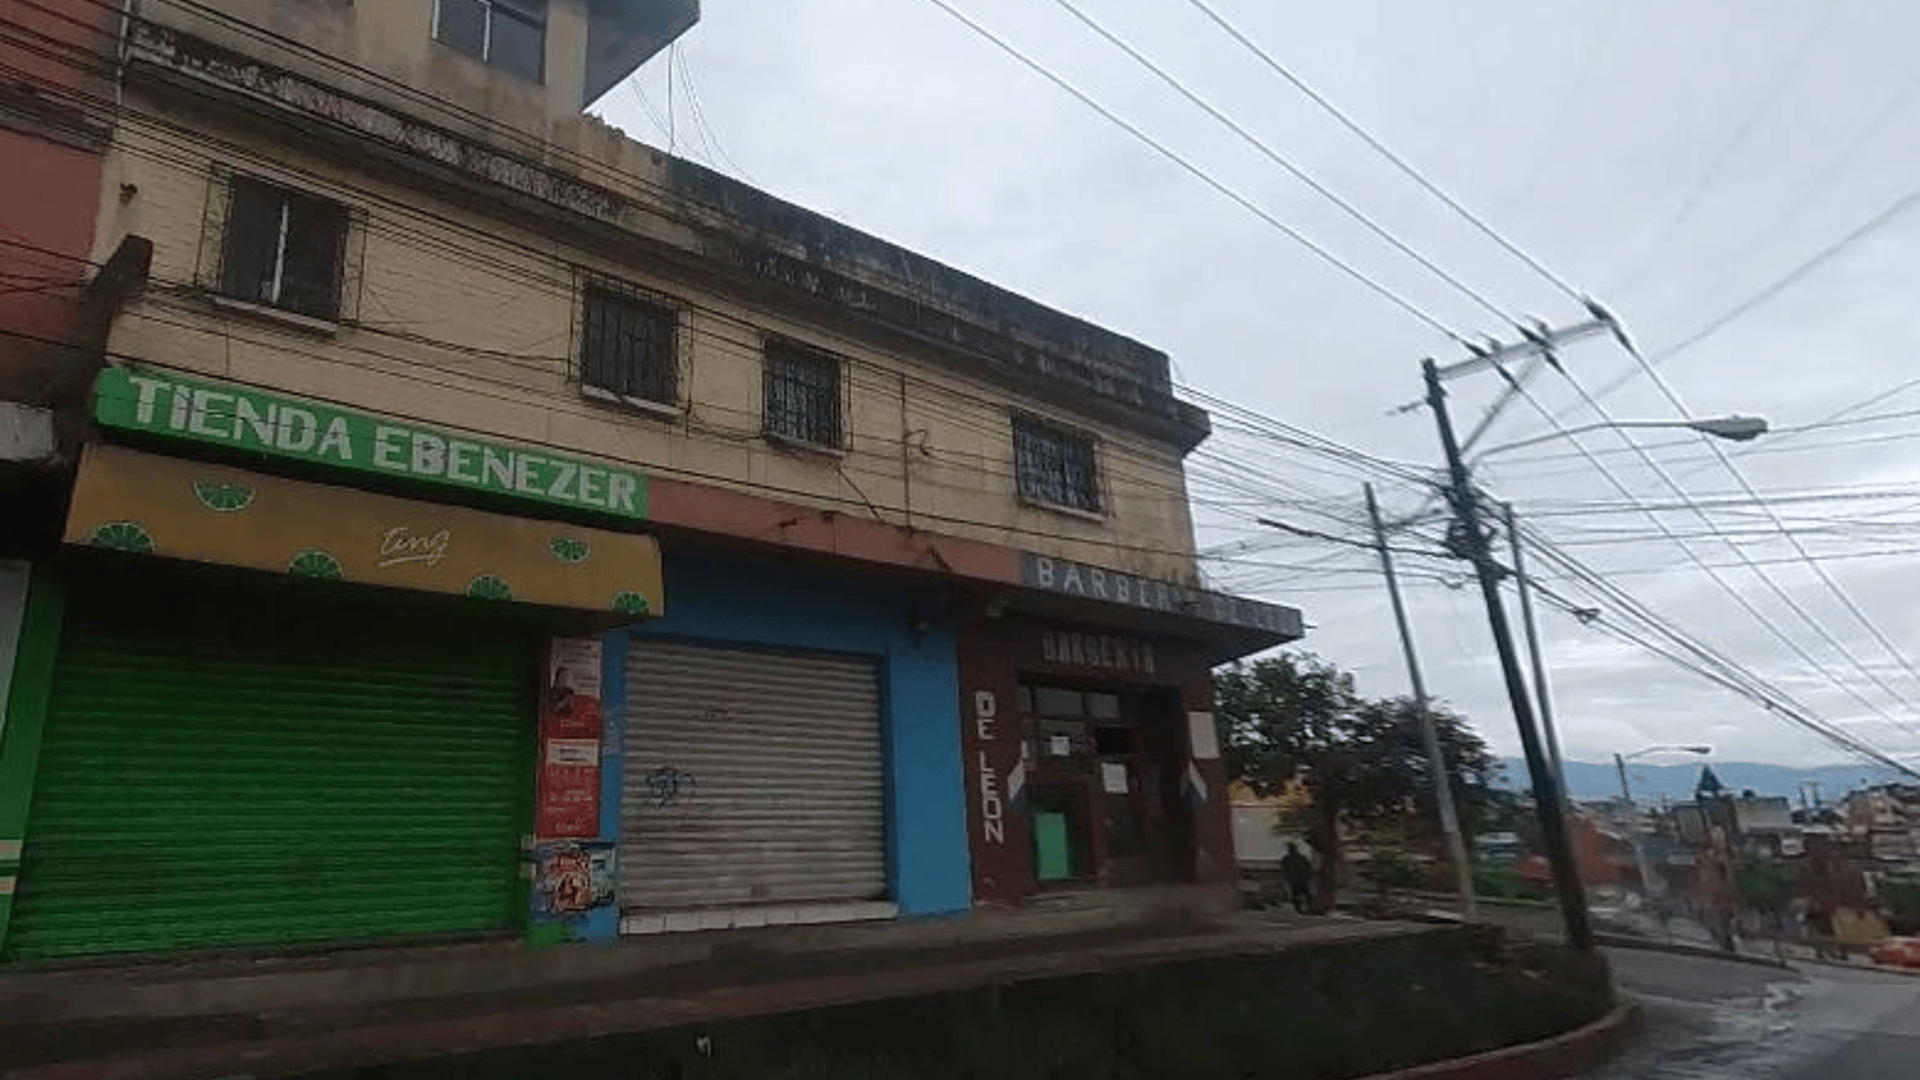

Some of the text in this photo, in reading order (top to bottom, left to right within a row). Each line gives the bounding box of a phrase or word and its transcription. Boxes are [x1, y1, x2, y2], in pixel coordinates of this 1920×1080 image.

[128, 376, 637, 514] TIENDA EBENEZER
[974, 689, 1005, 845] DE LEON
